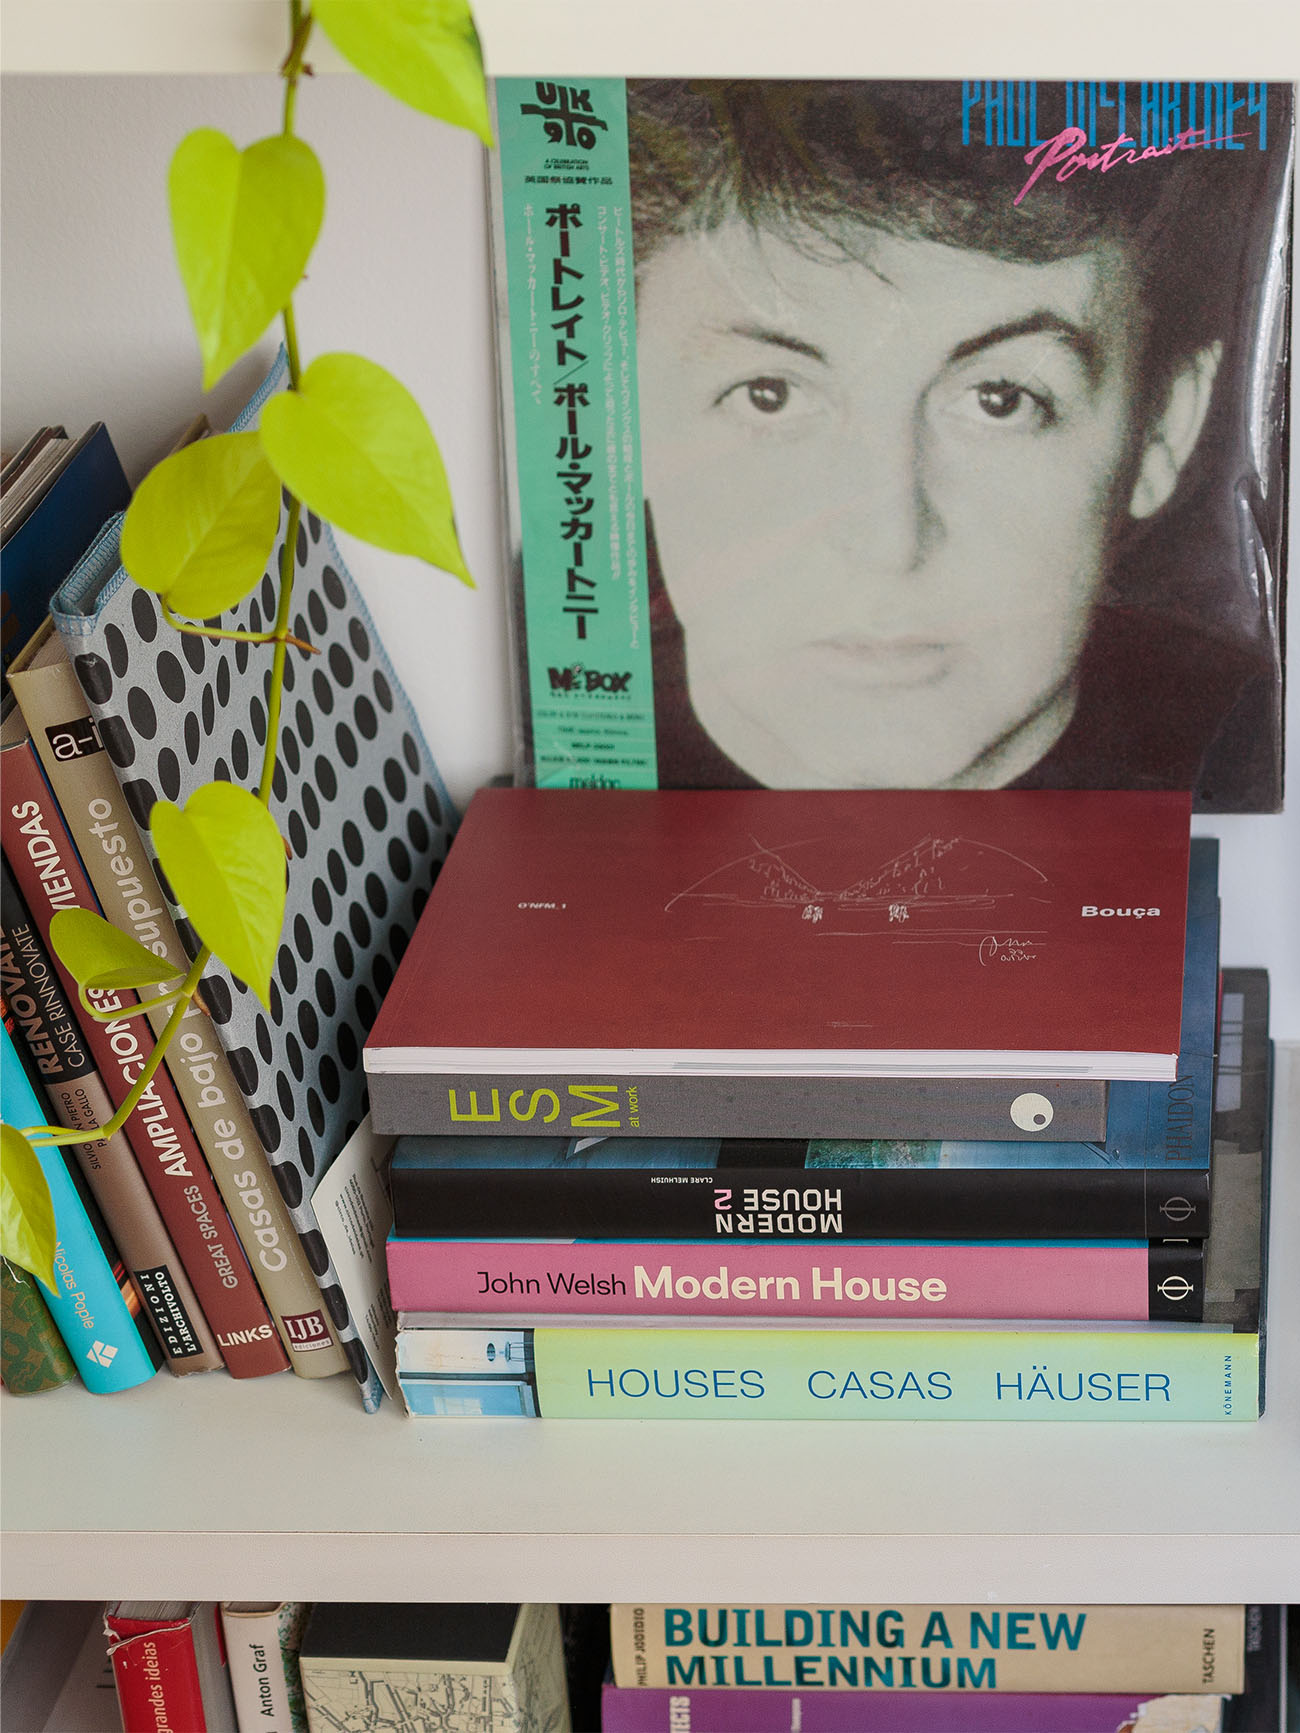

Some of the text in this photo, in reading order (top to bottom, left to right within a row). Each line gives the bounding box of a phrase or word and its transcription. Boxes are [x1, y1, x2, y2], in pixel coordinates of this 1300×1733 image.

[1013, 126, 1253, 206] Portrait
[88, 798, 202, 1021] prsupuesto
[1081, 905, 1161, 919] Bouça
[12, 923, 86, 1068] CASE RINNOVATE
[180, 1032, 227, 1108] bajo
[61, 1092, 80, 1121] PIETRO
[75, 1088, 94, 1117] GALLO
[625, 1085, 641, 1128] at work
[1165, 1074, 1195, 1162] PHAIDON
[83, 1143, 101, 1170] SILVIO
[214, 1117, 246, 1160] de
[650, 1176, 714, 1184] CLARE MELHUISH
[713, 1188, 843, 1211] HOUSE 2
[184, 1184, 239, 1290] GREAT SPACES
[715, 1213, 843, 1234] MODERN
[477, 1265, 948, 1301] John Welsh Modern House
[70, 1291, 95, 1329] Pople
[140, 1273, 183, 1355] EDIZIONI
[154, 1271, 197, 1353] L'ARCHIVOLTO
[284, 1315, 324, 1341] IJB
[216, 1324, 274, 1347] LINKS
[586, 1364, 1172, 1402] HOUSES CASAS HÄUSER
[663, 1607, 1087, 1652] BUILDING A NEW
[142, 1641, 161, 1681] ideias
[666, 1654, 998, 1690] MILLENNIUM
[1202, 1627, 1216, 1684] TASCHEN
[249, 1643, 275, 1717] Anton Graf
